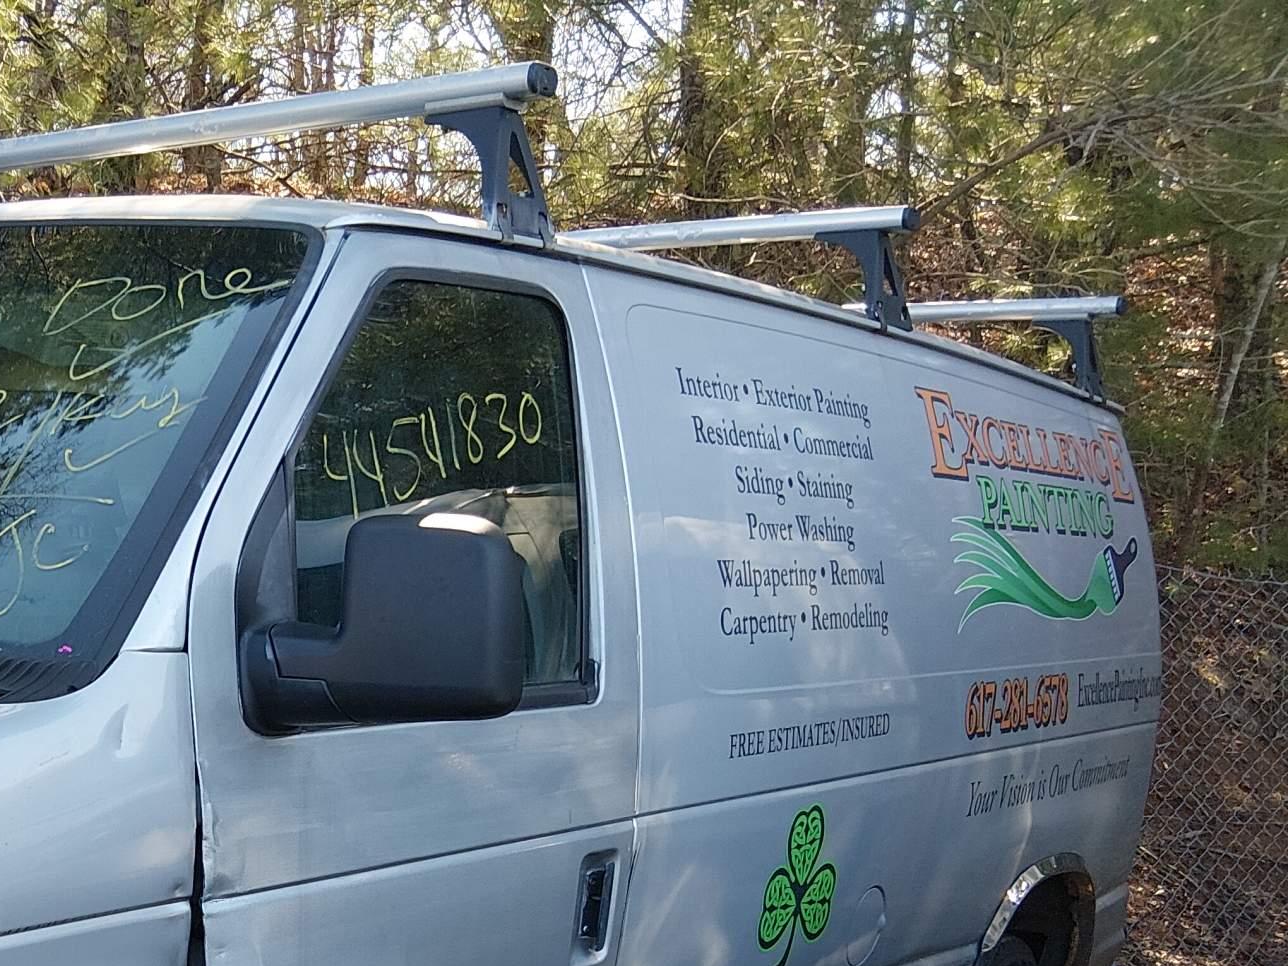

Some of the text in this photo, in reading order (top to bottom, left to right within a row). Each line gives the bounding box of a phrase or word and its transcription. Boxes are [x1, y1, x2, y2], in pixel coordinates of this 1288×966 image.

[42, 268, 291, 336] Done
[675, 367, 872, 429] Interior Exterior Painting
[323, 391, 542, 520] 44541830
[691, 415, 874, 460] Residential Commercial
[914, 386, 1135, 504] EXCELLENCE
[735, 466, 855, 509] Siding Staining
[976, 475, 1114, 539] PAINTING
[746, 513, 856, 552] Power Washing
[717, 559, 885, 597] Wallpapering Removal
[721, 603, 889, 644] Carpentry Remodeling
[728, 713, 891, 759] FREE ESTIMATES/INSURED
[965, 672, 1069, 740] 617-281-6578
[966, 755, 1130, 817] Your Vision is Our Commitment
